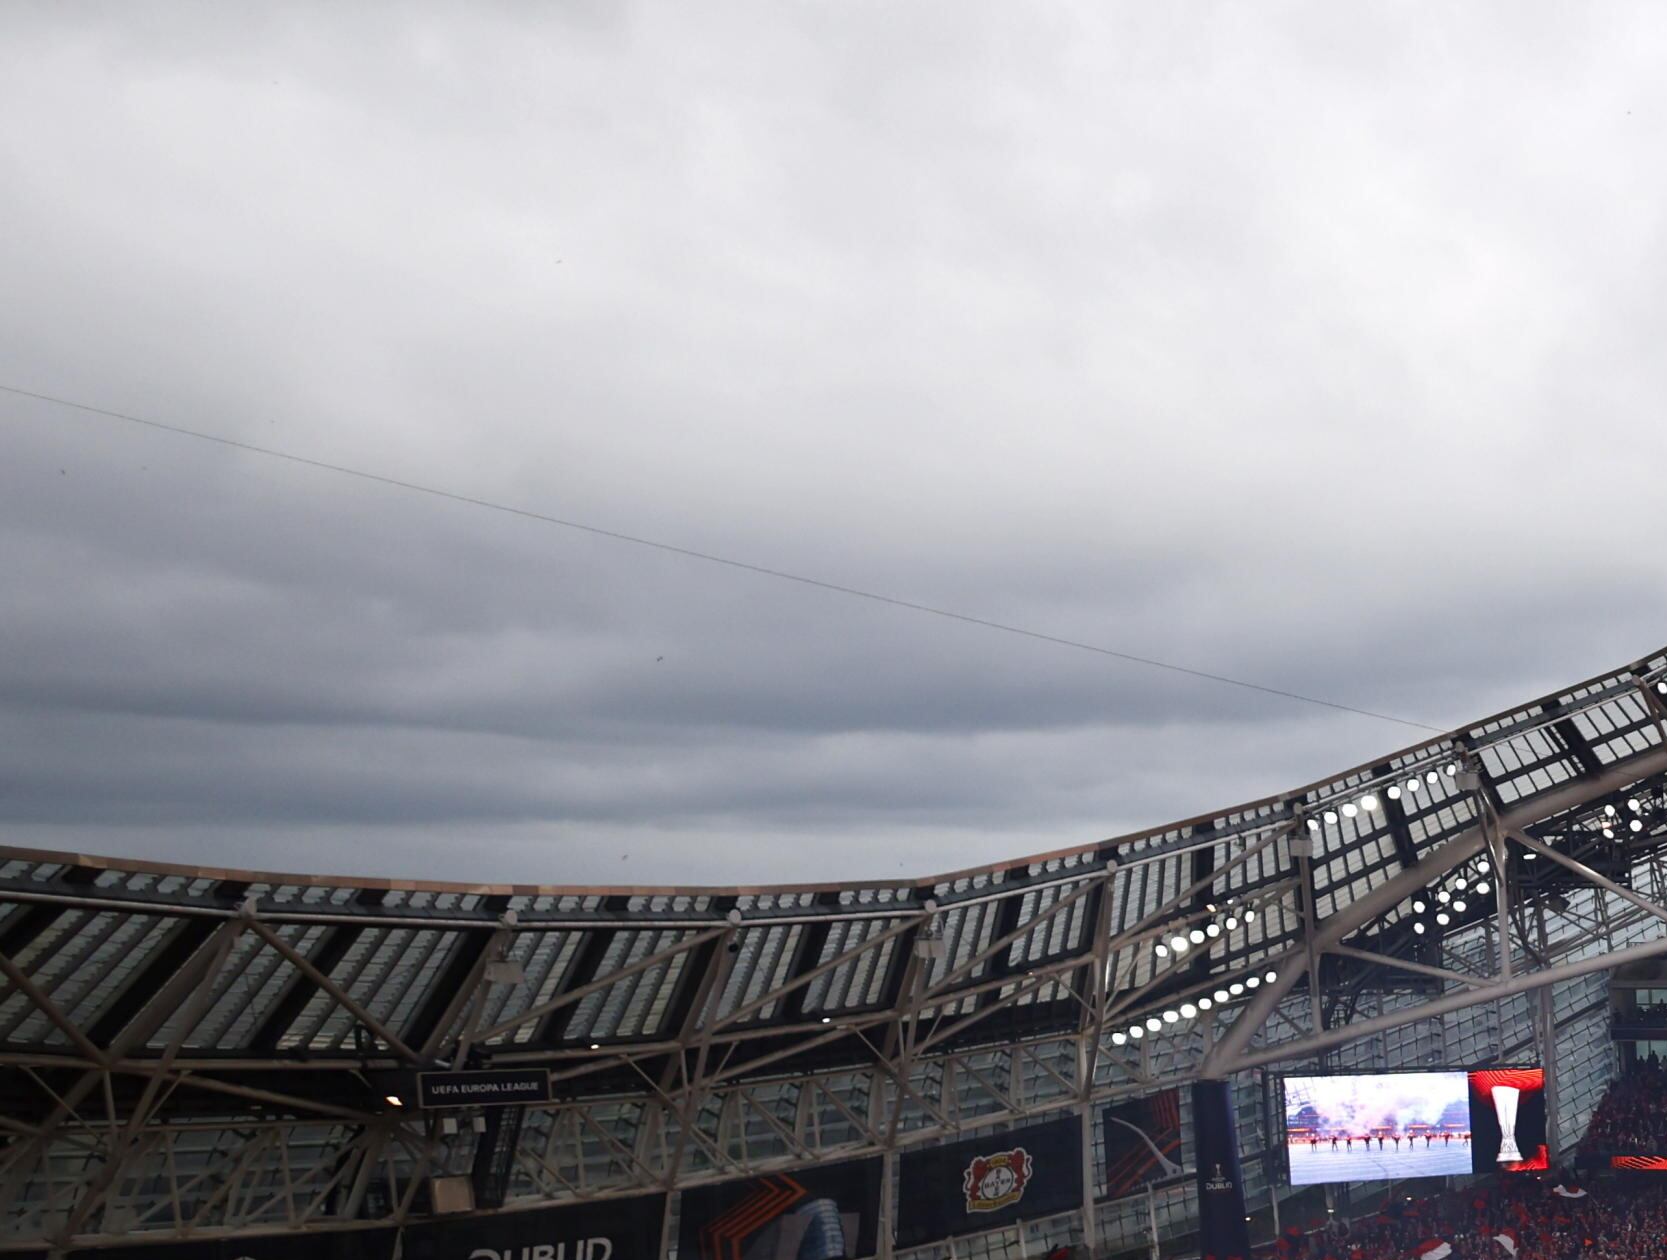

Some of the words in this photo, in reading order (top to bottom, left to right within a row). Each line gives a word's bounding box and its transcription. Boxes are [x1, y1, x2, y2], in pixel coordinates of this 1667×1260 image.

[431, 1085, 459, 1094] UEFA
[461, 1083, 500, 1093] EUROPA
[501, 1081, 539, 1091] LEAGUE
